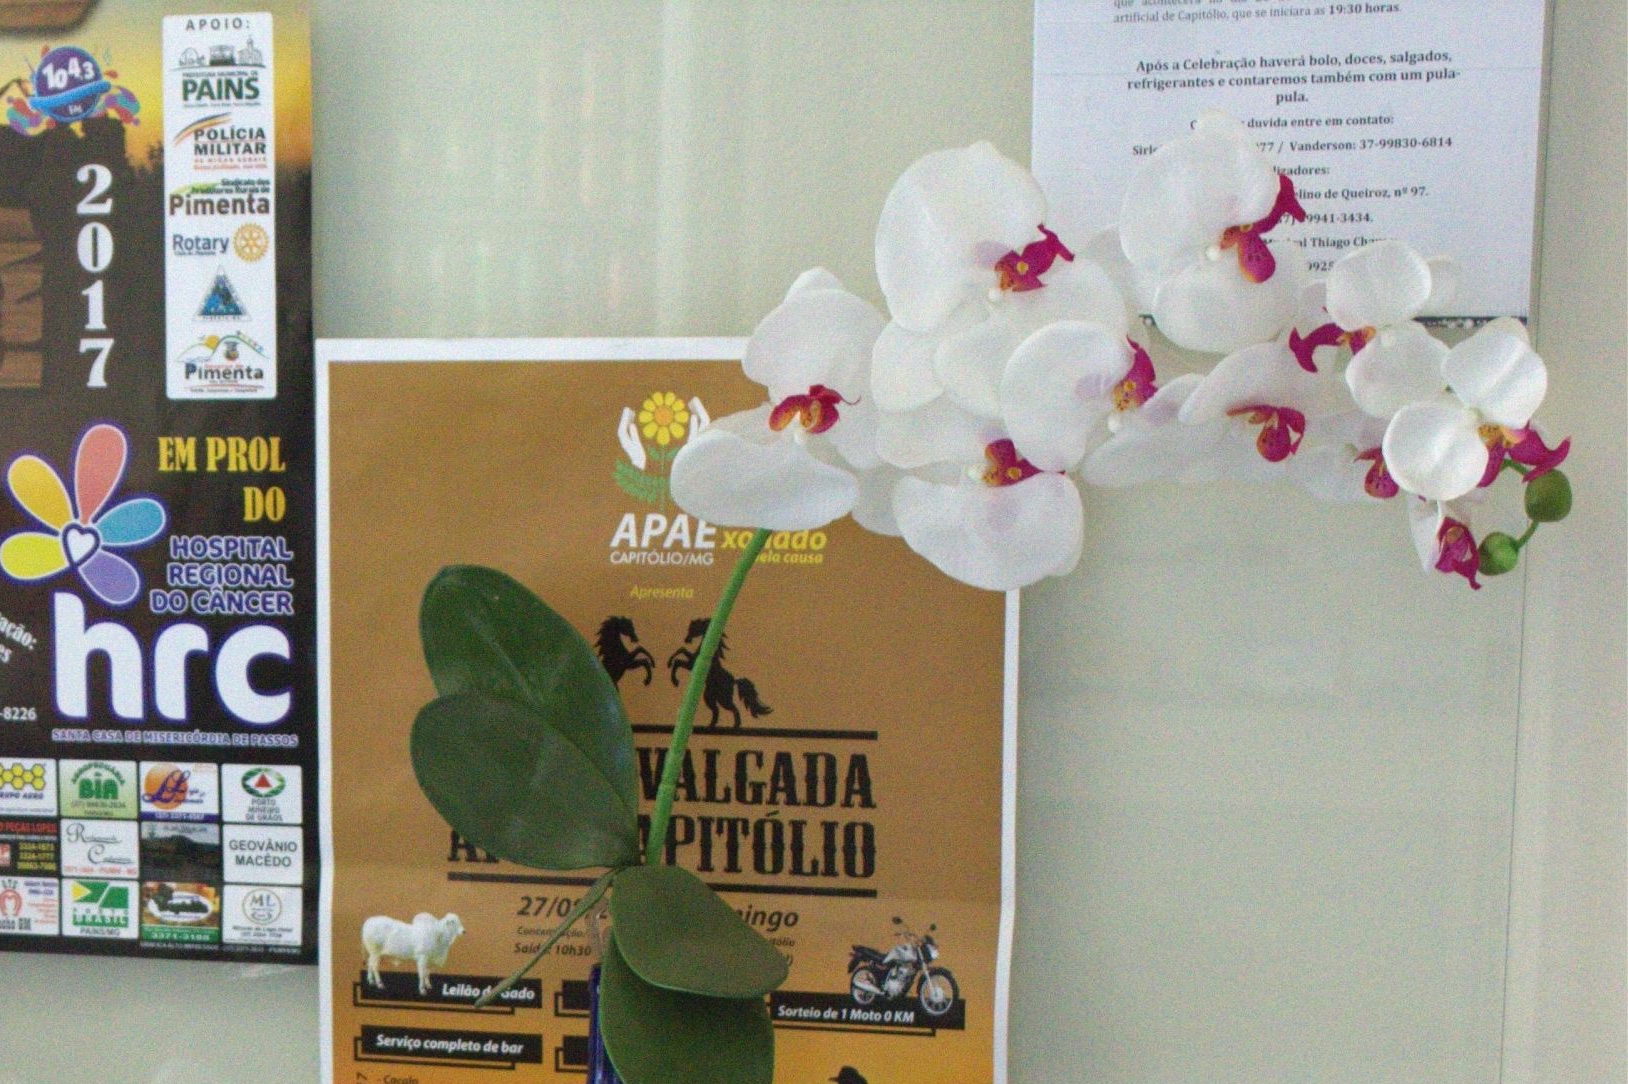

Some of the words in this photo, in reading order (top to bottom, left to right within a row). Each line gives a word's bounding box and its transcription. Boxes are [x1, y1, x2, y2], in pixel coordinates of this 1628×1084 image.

[1114, 11, 1159, 23] artificial
[1328, 4, 1362, 15] 19:30
[1136, 59, 1169, 74] Após
[1183, 57, 1256, 71] Celebração
[1259, 55, 1305, 68] haverá
[1309, 54, 1341, 67] bolo,
[1345, 53, 1386, 65] doces,
[1389, 50, 1452, 65] salgados,
[182, 77, 260, 101] PAINS
[1127, 76, 1215, 92] refrigerantes
[1228, 74, 1307, 87] contaremos
[1310, 69, 1365, 83] também
[1368, 71, 1397, 82] com
[1400, 70, 1423, 81] um
[1426, 68, 1461, 83] pula-
[1275, 91, 1309, 105] pula.
[1247, 116, 1288, 128] duvida
[1290, 117, 1322, 127] entre
[1345, 115, 1394, 126] contato:
[193, 125, 266, 140] POLÍCIA
[194, 142, 266, 156] MILITAR
[1289, 139, 1356, 151] Vanderson:
[1359, 136, 1452, 149] 37-99830-6814
[1341, 188, 1390, 200] Queiroz,
[169, 193, 271, 215] Pimenta
[172, 234, 230, 254] Rotary
[1311, 237, 1351, 249] Thiago
[185, 362, 264, 380] Pimenta
[158, 436, 197, 472] EM
[206, 436, 286, 473] PROL
[243, 486, 286, 523] DO
[610, 512, 717, 549] APAE
[170, 534, 294, 561] HOSPITAL
[610, 549, 714, 566] CAPITÓLIO/MG
[166, 562, 294, 587] REGIONAL
[150, 590, 189, 614] DO
[193, 586, 294, 615] CÂNCER
[630, 585, 695, 600] Apresenta
[53, 592, 293, 725] hrc
[250, 733, 299, 746] PASSOS
[778, 1005, 821, 1019] Sorteio
[849, 1009, 882, 1022] Moto
[893, 1011, 915, 1024] KM
[376, 1032, 421, 1052] Serviço
[423, 1035, 480, 1054] completo
[482, 1036, 499, 1052] de
[500, 1039, 525, 1055] bar
